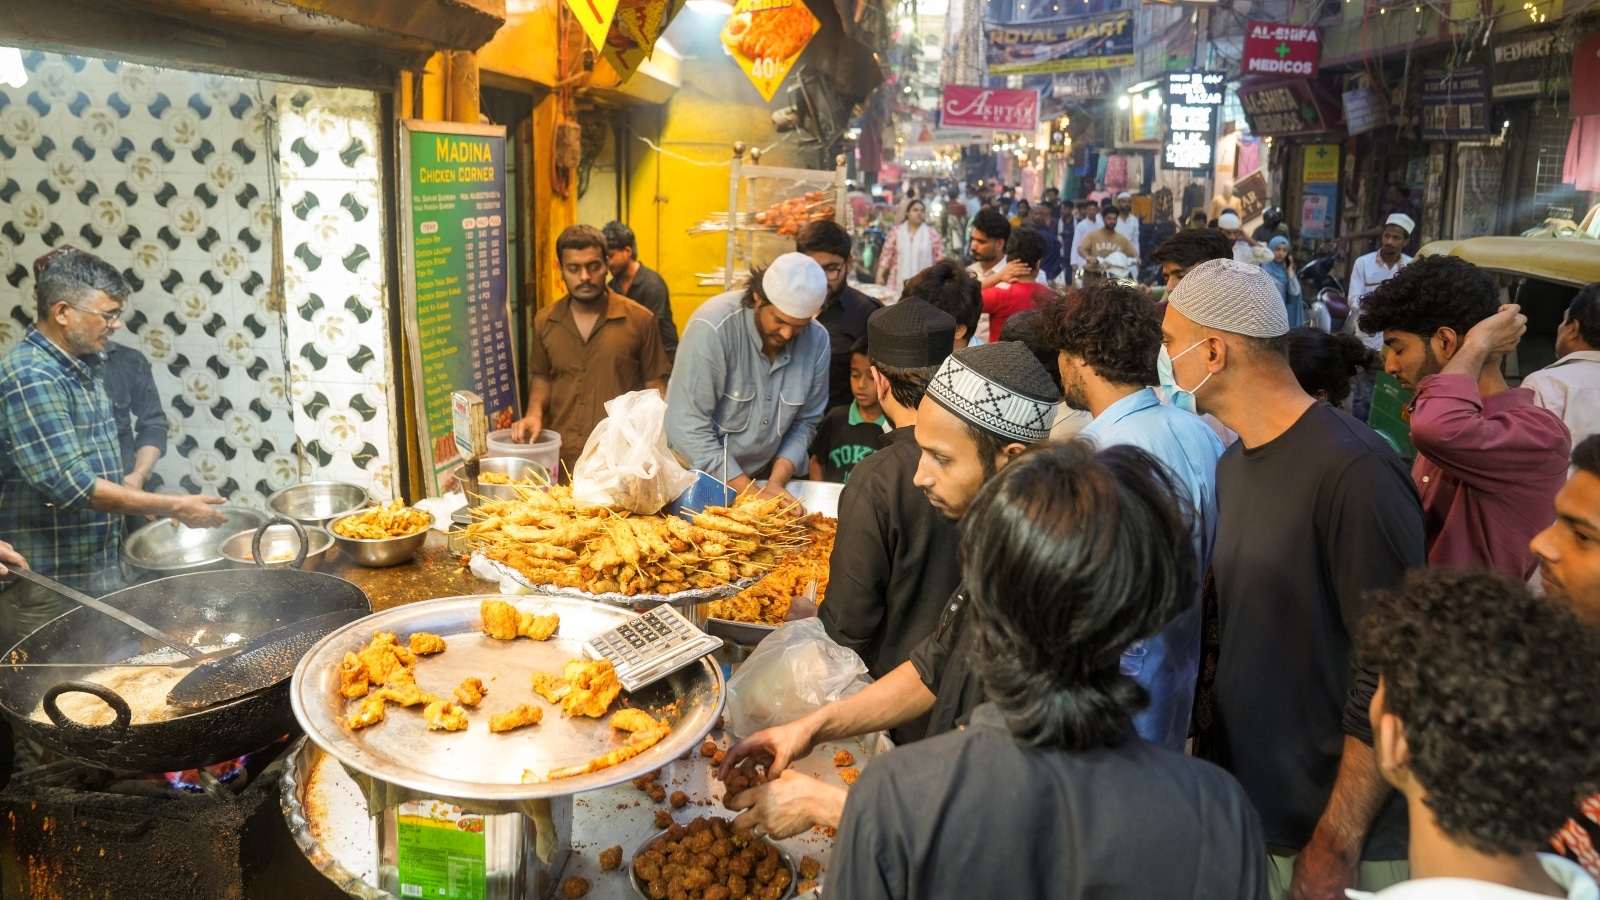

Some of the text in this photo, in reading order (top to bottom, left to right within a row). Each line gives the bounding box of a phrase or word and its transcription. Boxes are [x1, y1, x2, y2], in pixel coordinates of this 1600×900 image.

[989, 19, 1128, 45] ROYAL MART
[1250, 25, 1318, 43] AL-SHIFA
[1249, 58, 1313, 75] MEDICOS
[946, 90, 1032, 118] AKHTAR
[436, 137, 492, 162] MADINA
[420, 167, 494, 183] CHICKEN CORNER
